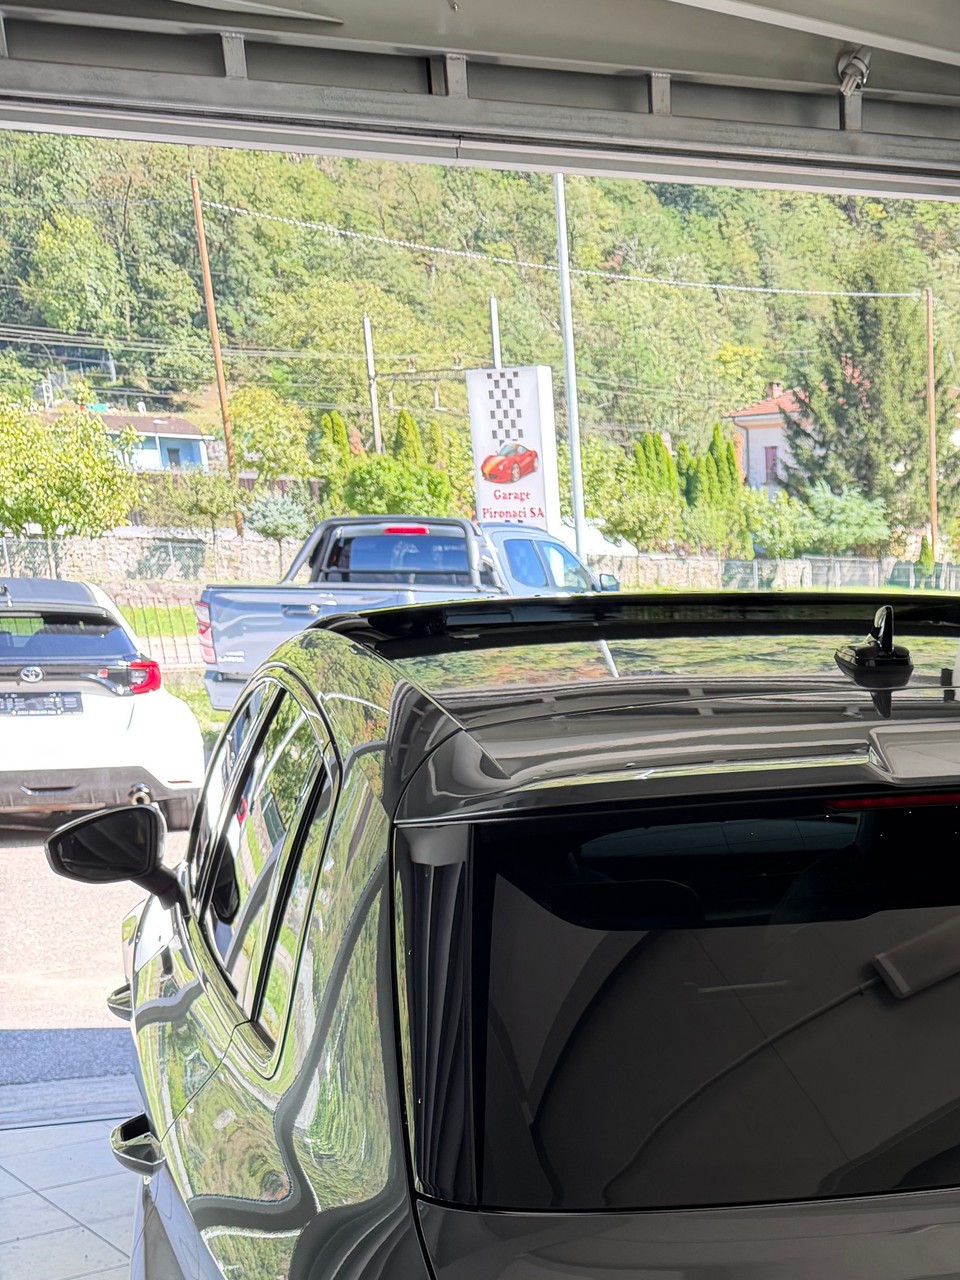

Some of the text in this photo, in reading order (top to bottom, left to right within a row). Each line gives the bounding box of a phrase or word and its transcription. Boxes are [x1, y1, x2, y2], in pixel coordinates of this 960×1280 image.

[493, 489, 530, 502] Garage
[482, 507, 545, 518] Pironaci SA
